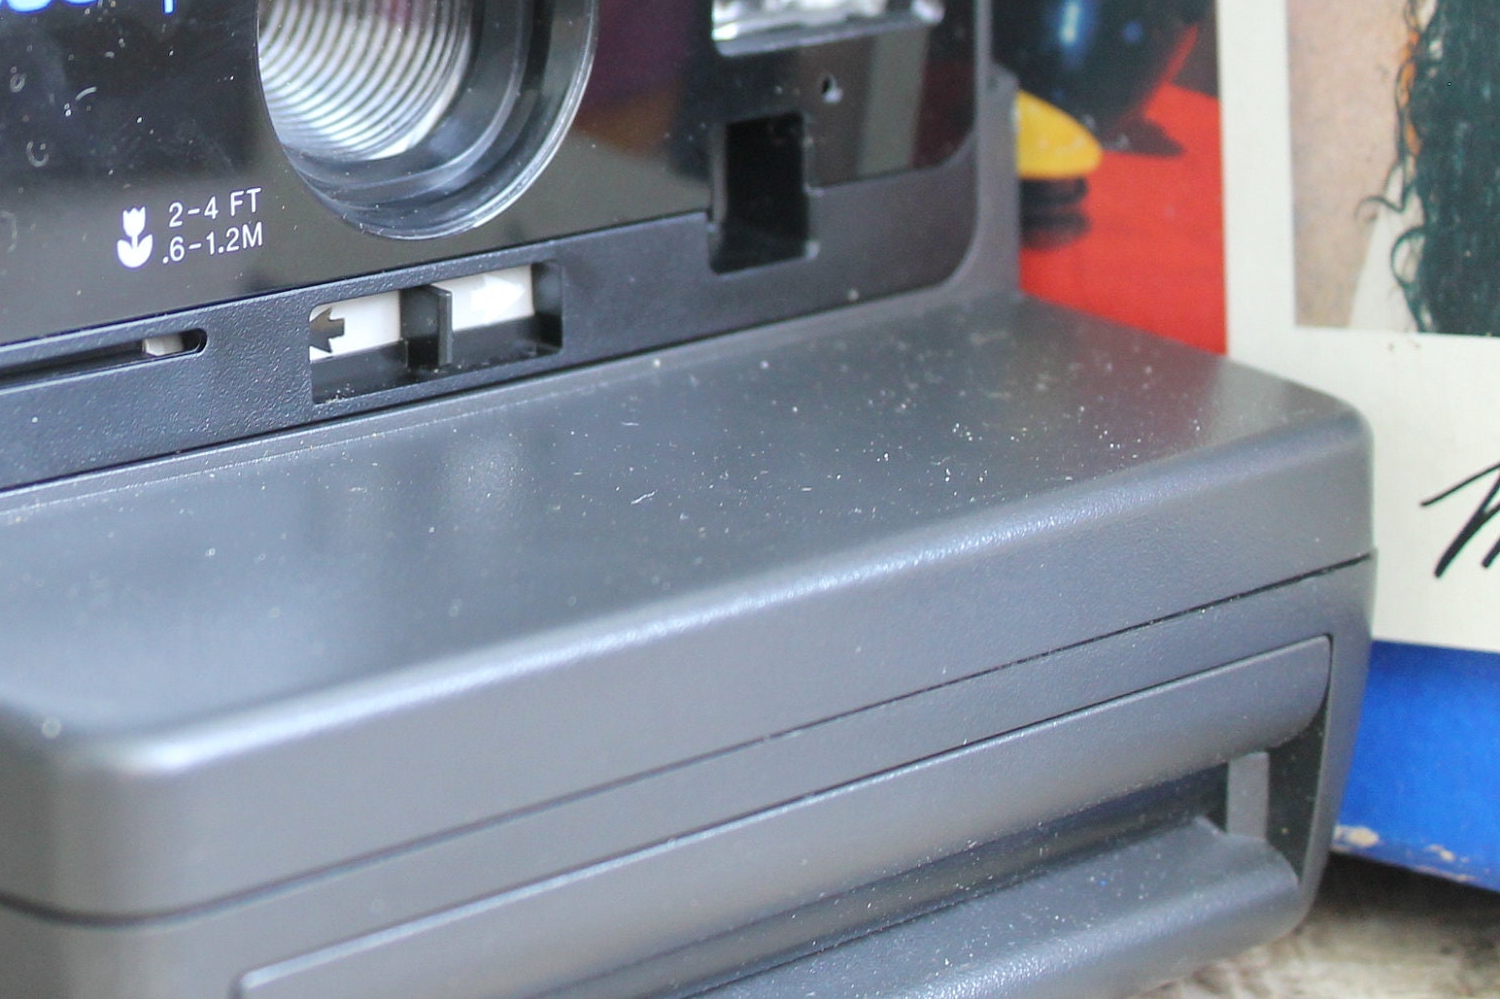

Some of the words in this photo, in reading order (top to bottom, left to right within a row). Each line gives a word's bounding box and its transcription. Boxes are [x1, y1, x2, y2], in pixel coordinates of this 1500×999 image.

[168, 195, 219, 228] 2-4
[230, 187, 262, 217] FT
[162, 221, 264, 265] .6-1.2M
